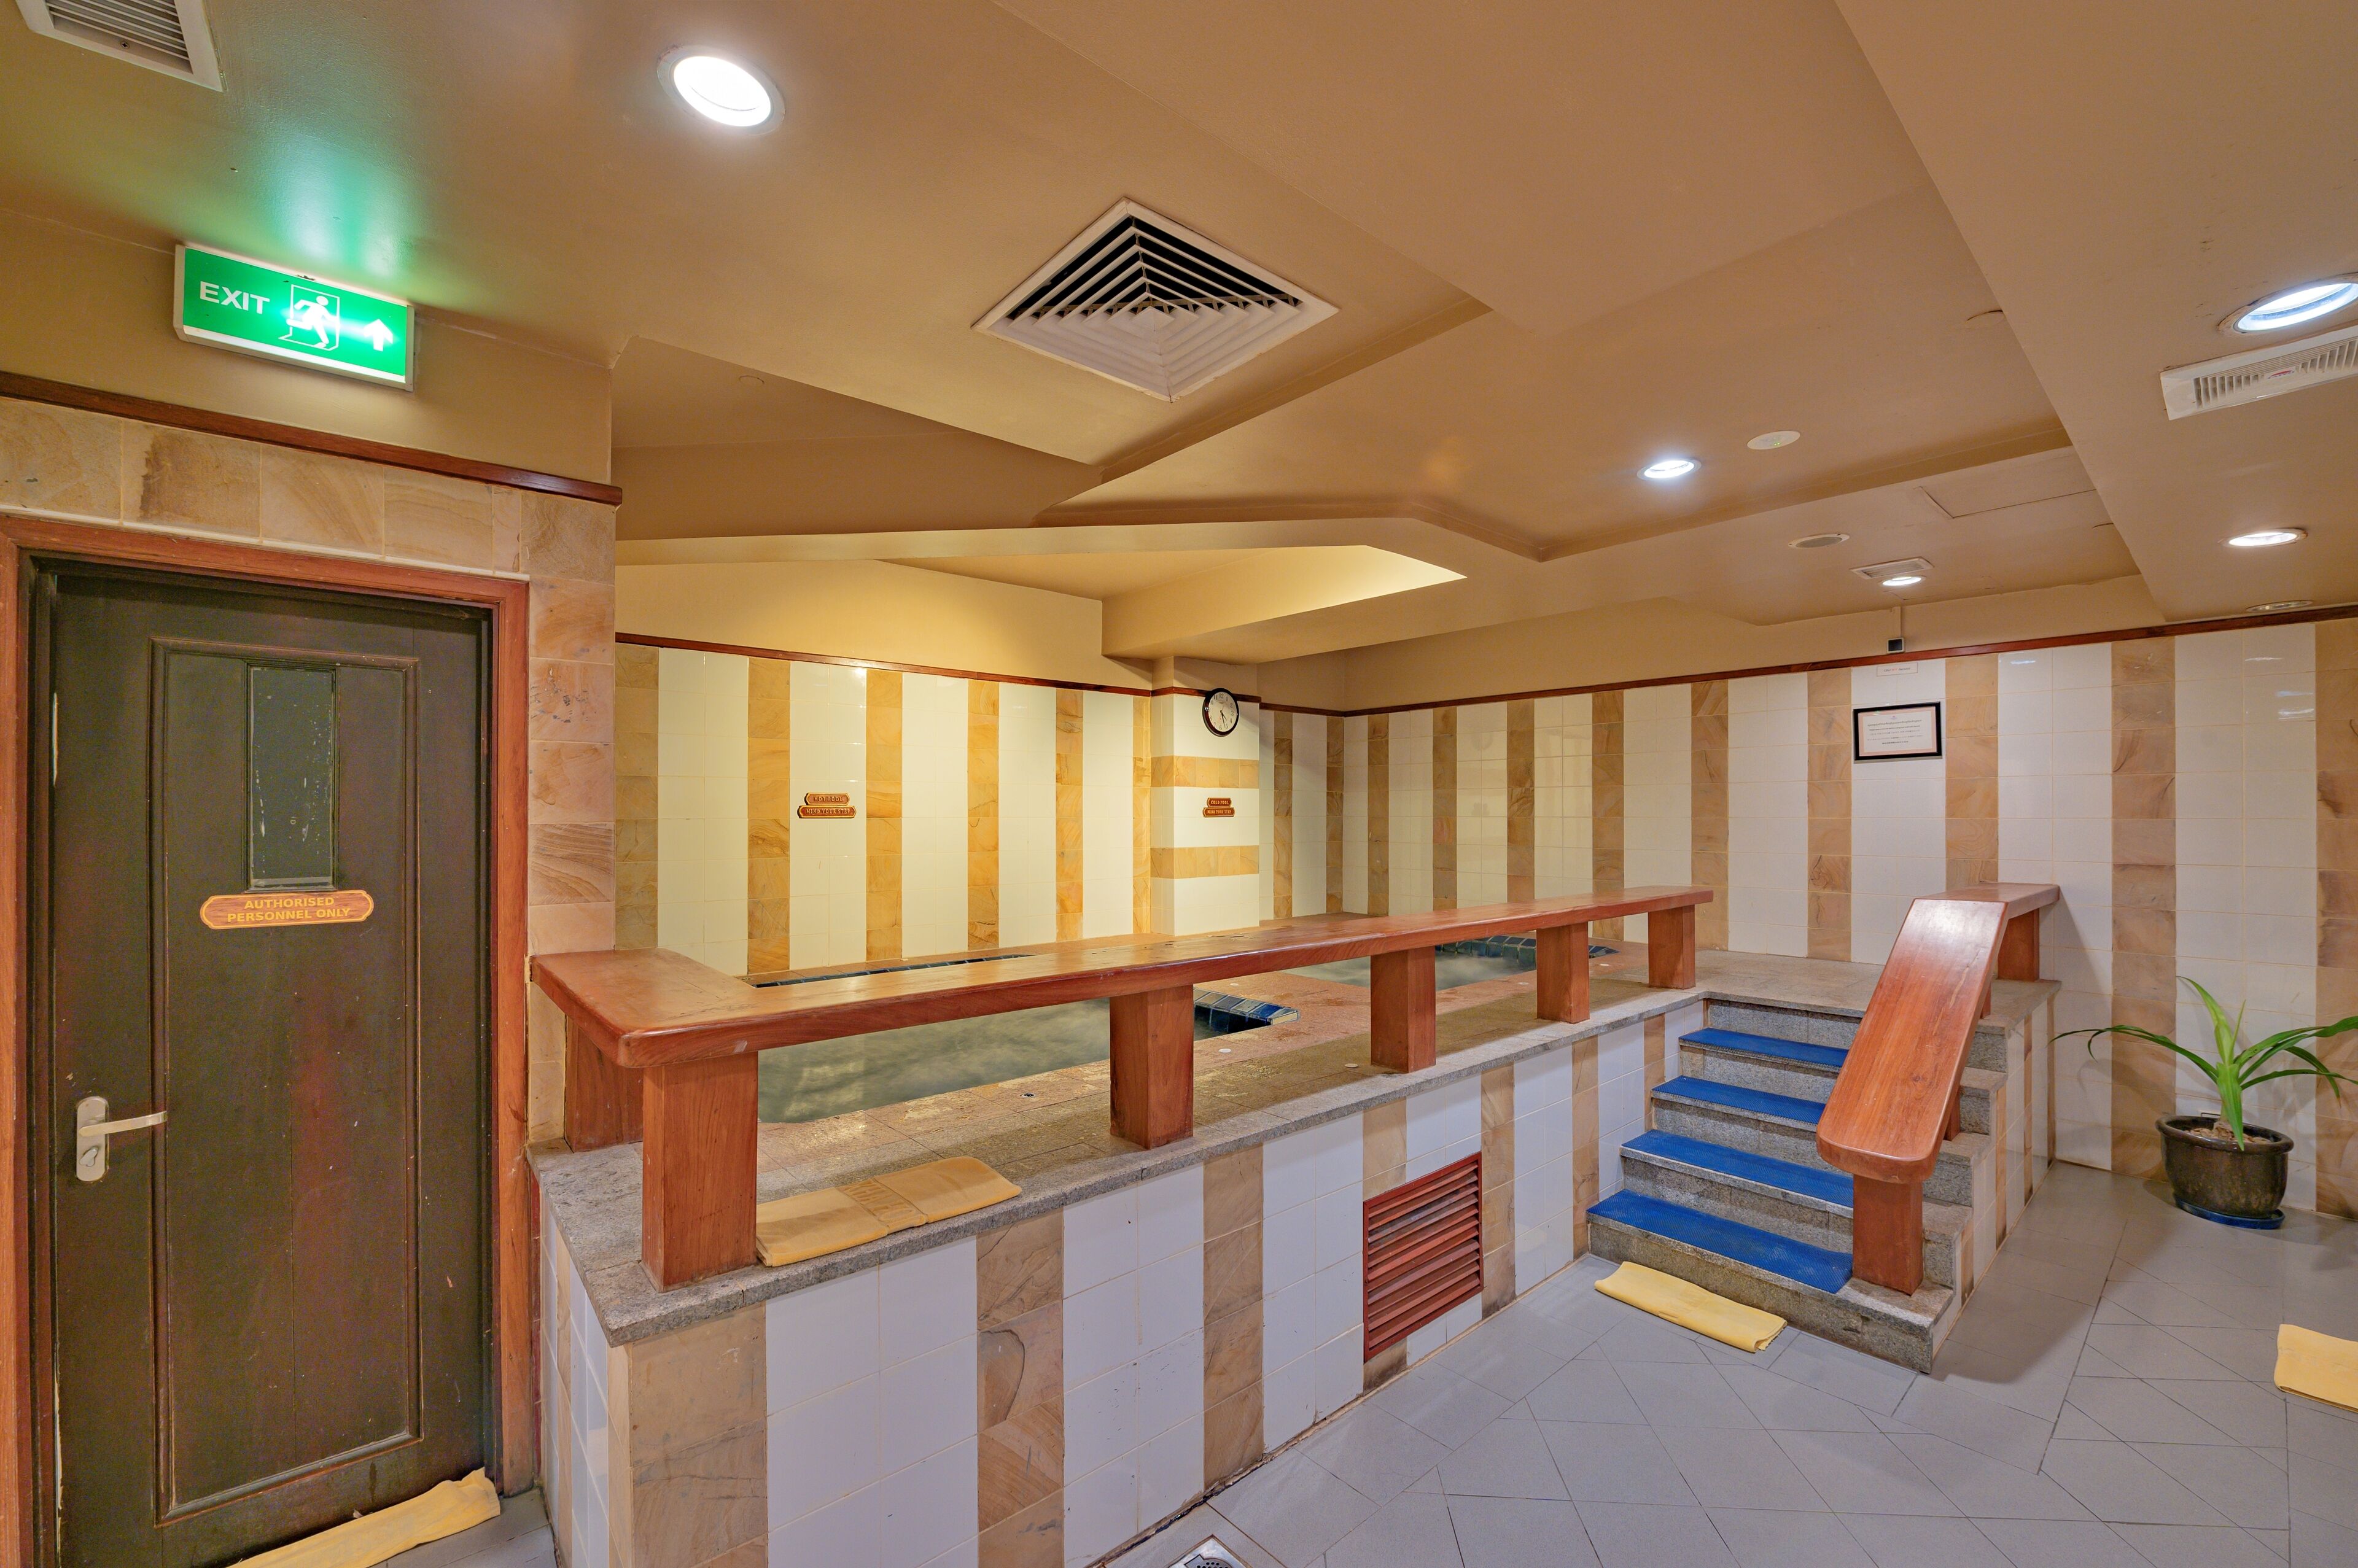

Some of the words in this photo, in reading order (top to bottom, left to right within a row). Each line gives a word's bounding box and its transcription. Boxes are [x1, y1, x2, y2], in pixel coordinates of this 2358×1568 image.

[200, 281, 270, 315] EXIT
[244, 897, 335, 909] AUTHORISED
[227, 909, 312, 923] PERSONNEL
[316, 907, 351, 918] ONLY
